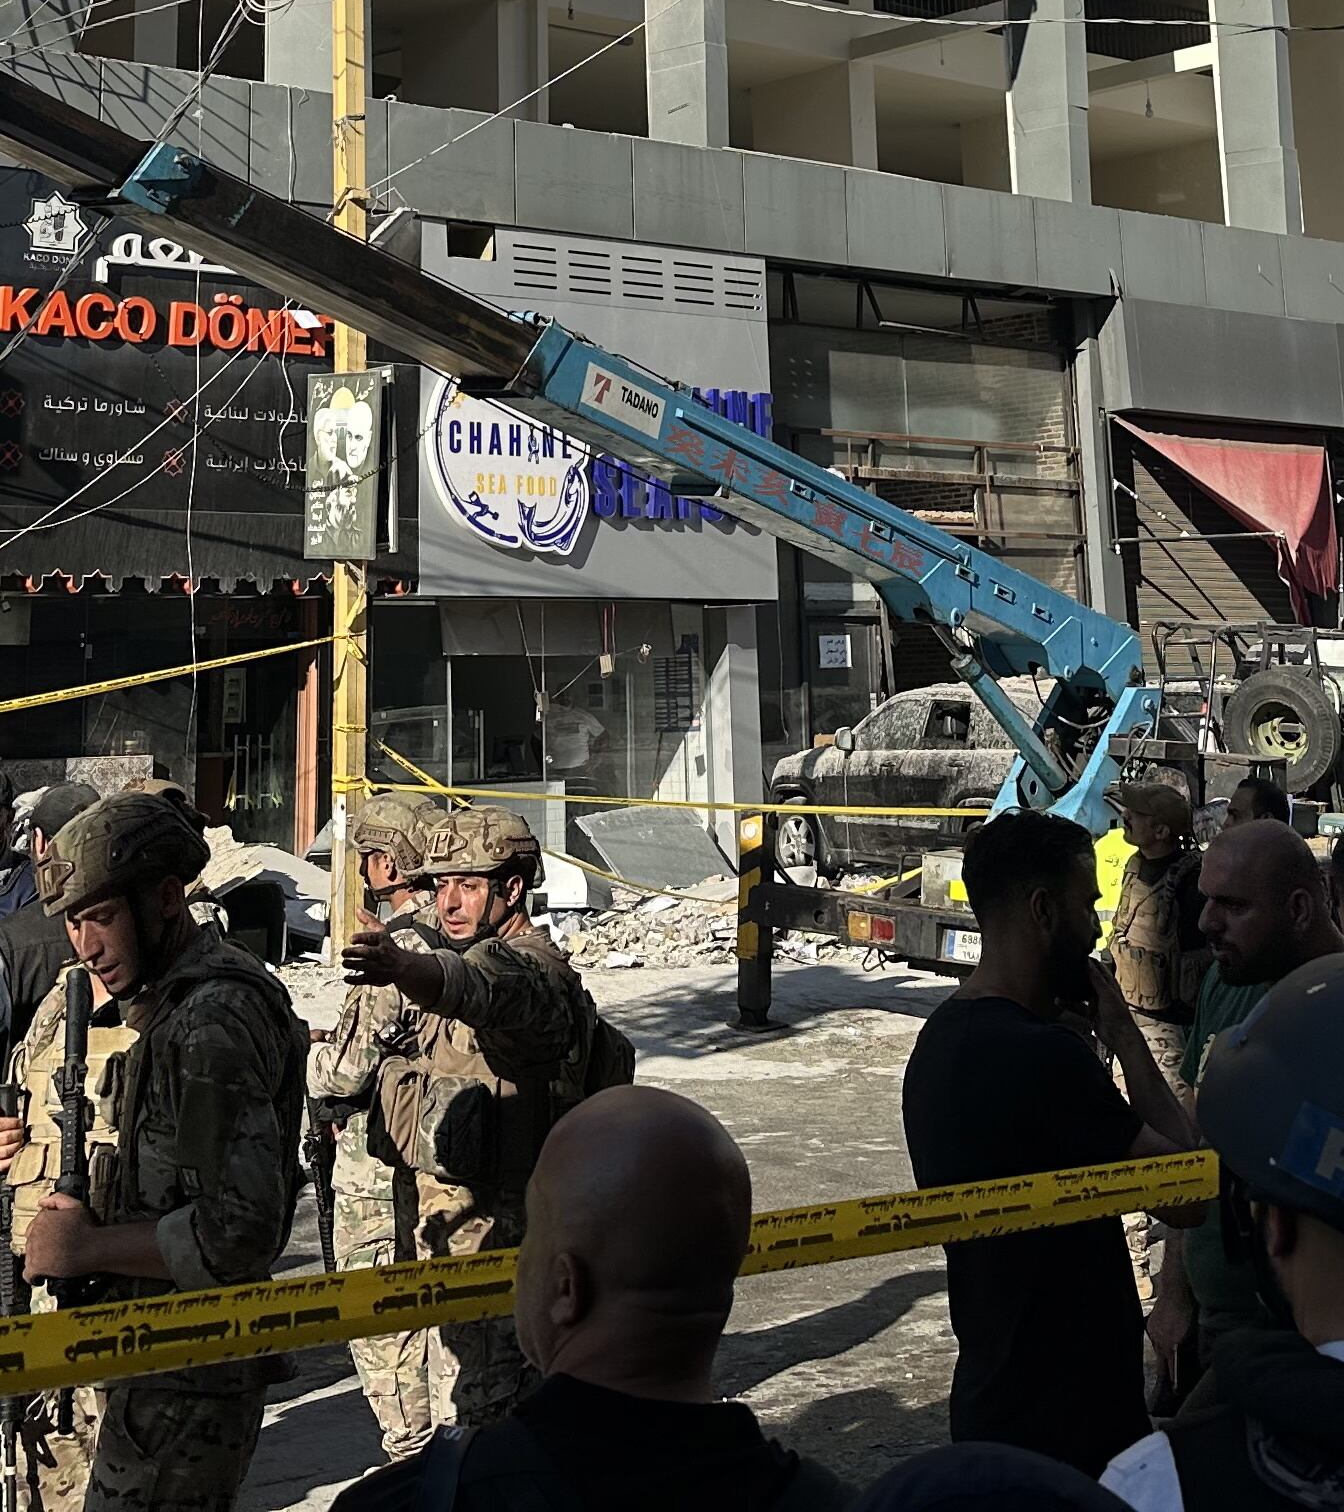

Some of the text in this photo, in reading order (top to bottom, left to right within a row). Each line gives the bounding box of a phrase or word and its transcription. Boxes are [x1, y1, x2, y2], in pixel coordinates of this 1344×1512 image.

[43, 393, 146, 417] شاورما تركية
[620, 385, 660, 420] TADANO
[475, 472, 558, 498] SEA FOOD
